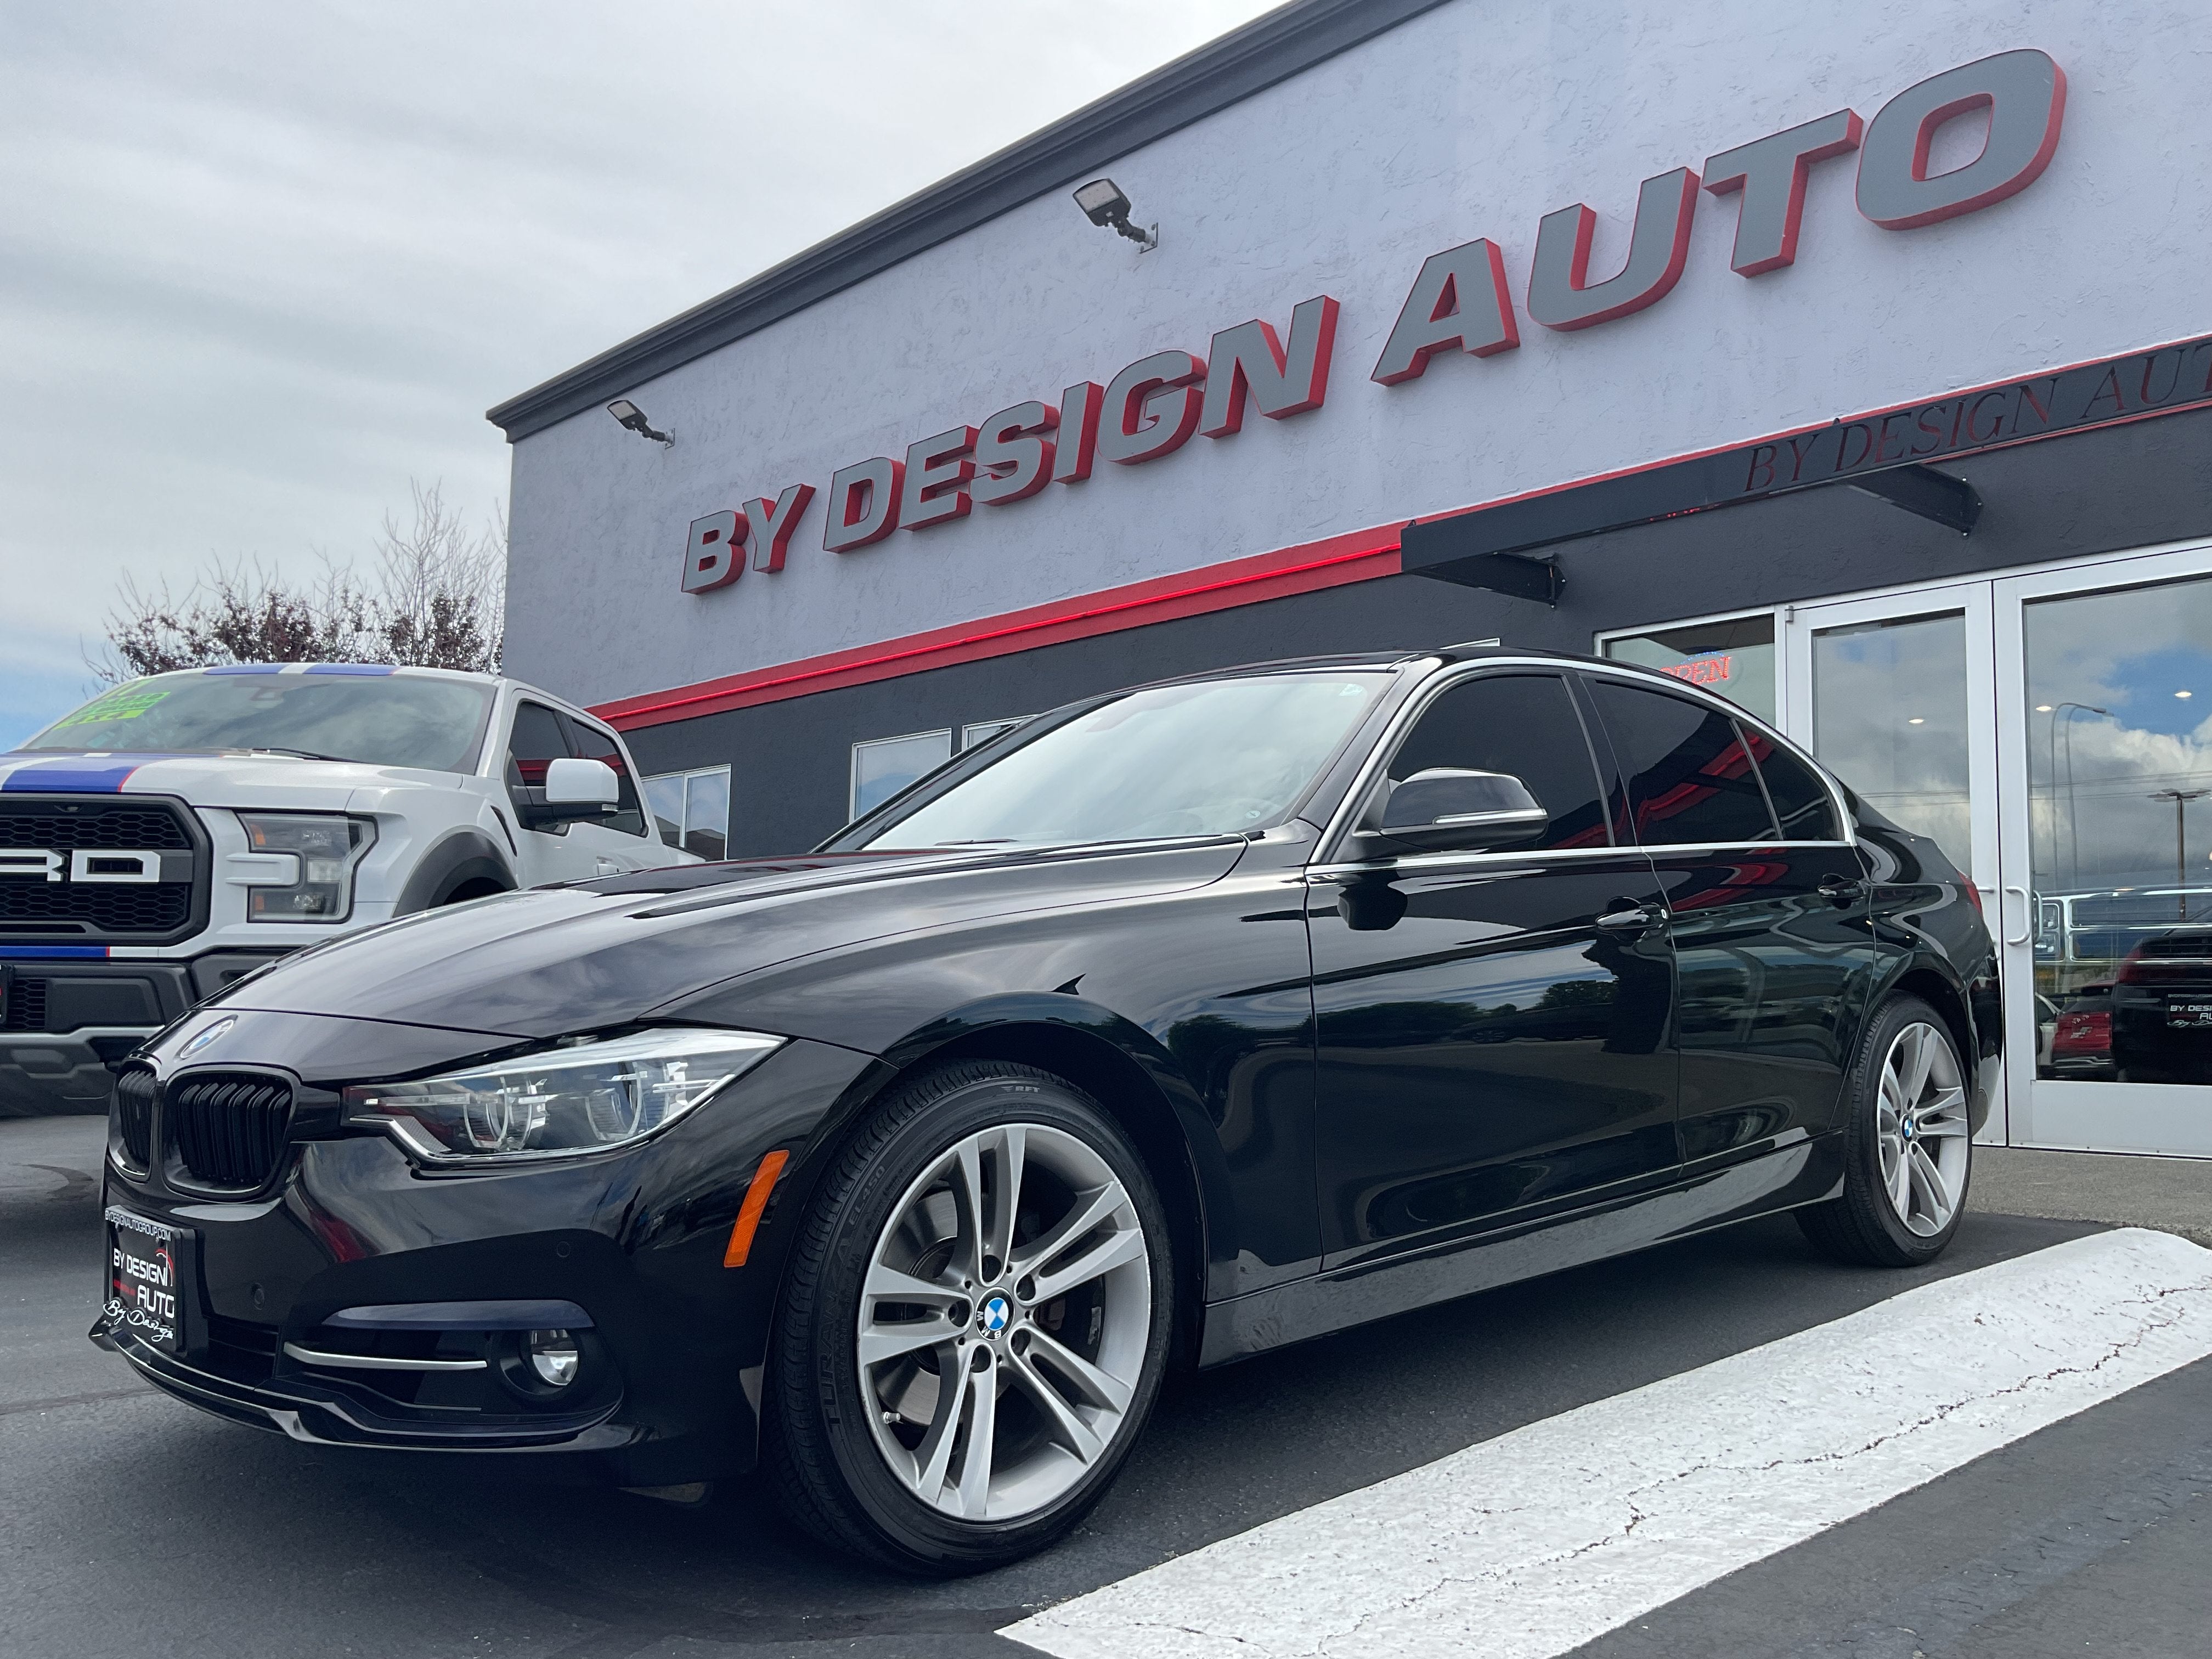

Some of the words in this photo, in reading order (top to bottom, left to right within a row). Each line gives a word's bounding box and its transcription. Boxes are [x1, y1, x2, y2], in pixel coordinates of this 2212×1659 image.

[681, 483, 816, 594] BY
[823, 295, 1340, 554] DESIGN
[1370, 49, 2067, 386] AUTO
[1743, 433, 1818, 492] BY
[1833, 377, 2062, 472] DESIGN
[114, 1248, 125, 1269] BY
[126, 1254, 167, 1287] DESIGN
[103, 1299, 127, 1325] By
[127, 1309, 174, 1342] Design
[137, 1284, 175, 1319] AUTO
[977, 1310, 1002, 1339] BMW
